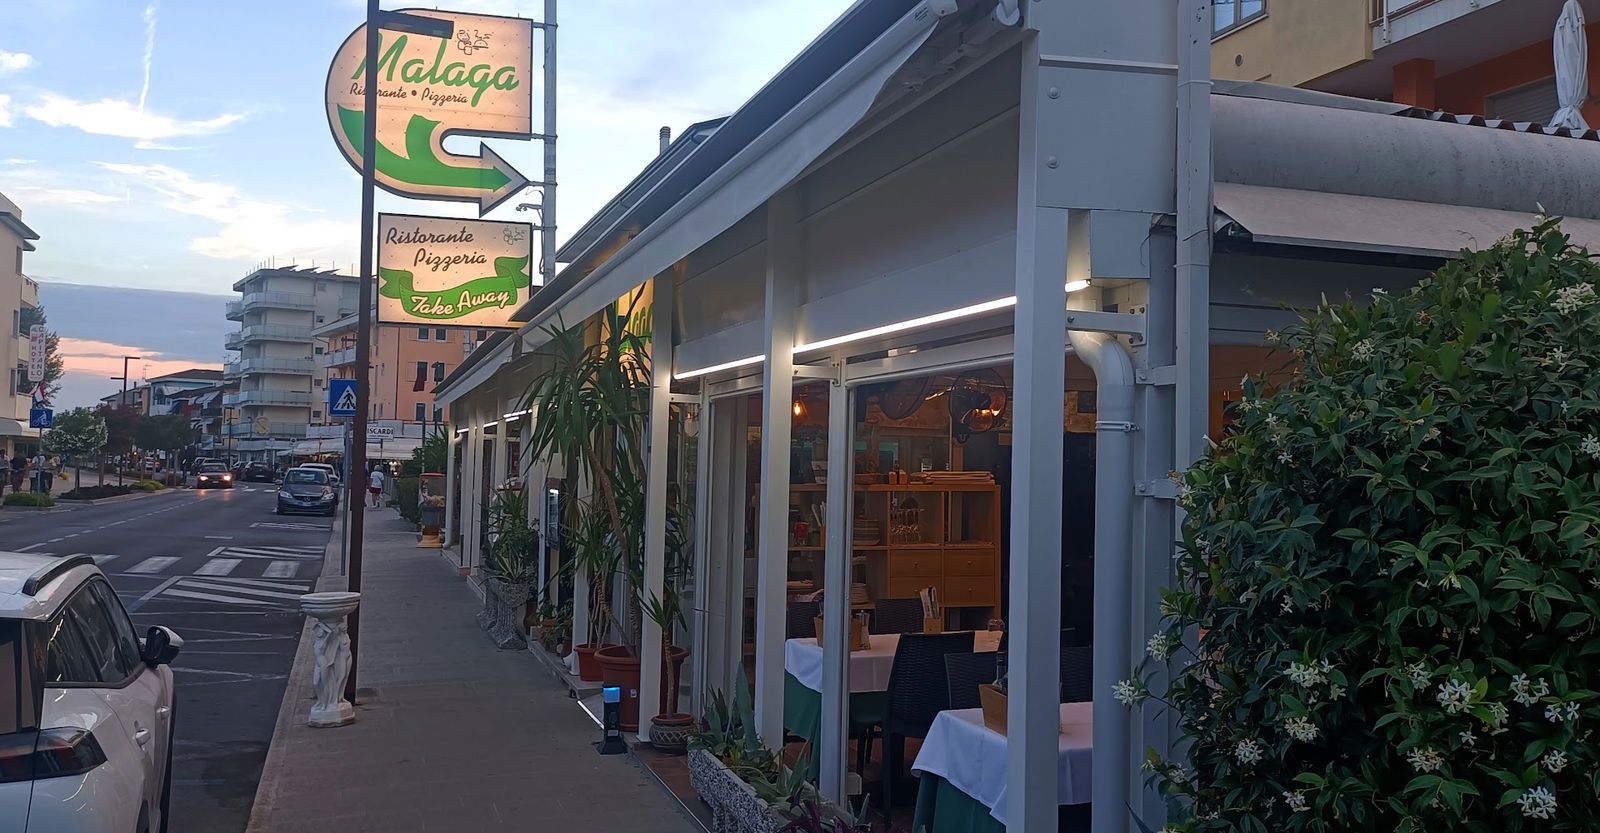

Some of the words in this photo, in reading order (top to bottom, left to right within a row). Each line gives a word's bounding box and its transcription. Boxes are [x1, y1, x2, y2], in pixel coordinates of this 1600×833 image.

[351, 32, 519, 107] Malaga
[350, 82, 407, 99] Risrante
[421, 88, 469, 106] Pizzeria
[385, 226, 474, 245] Ristorante
[413, 248, 487, 272] Pizzeria
[410, 295, 454, 315] Take
[456, 290, 510, 309] Away
